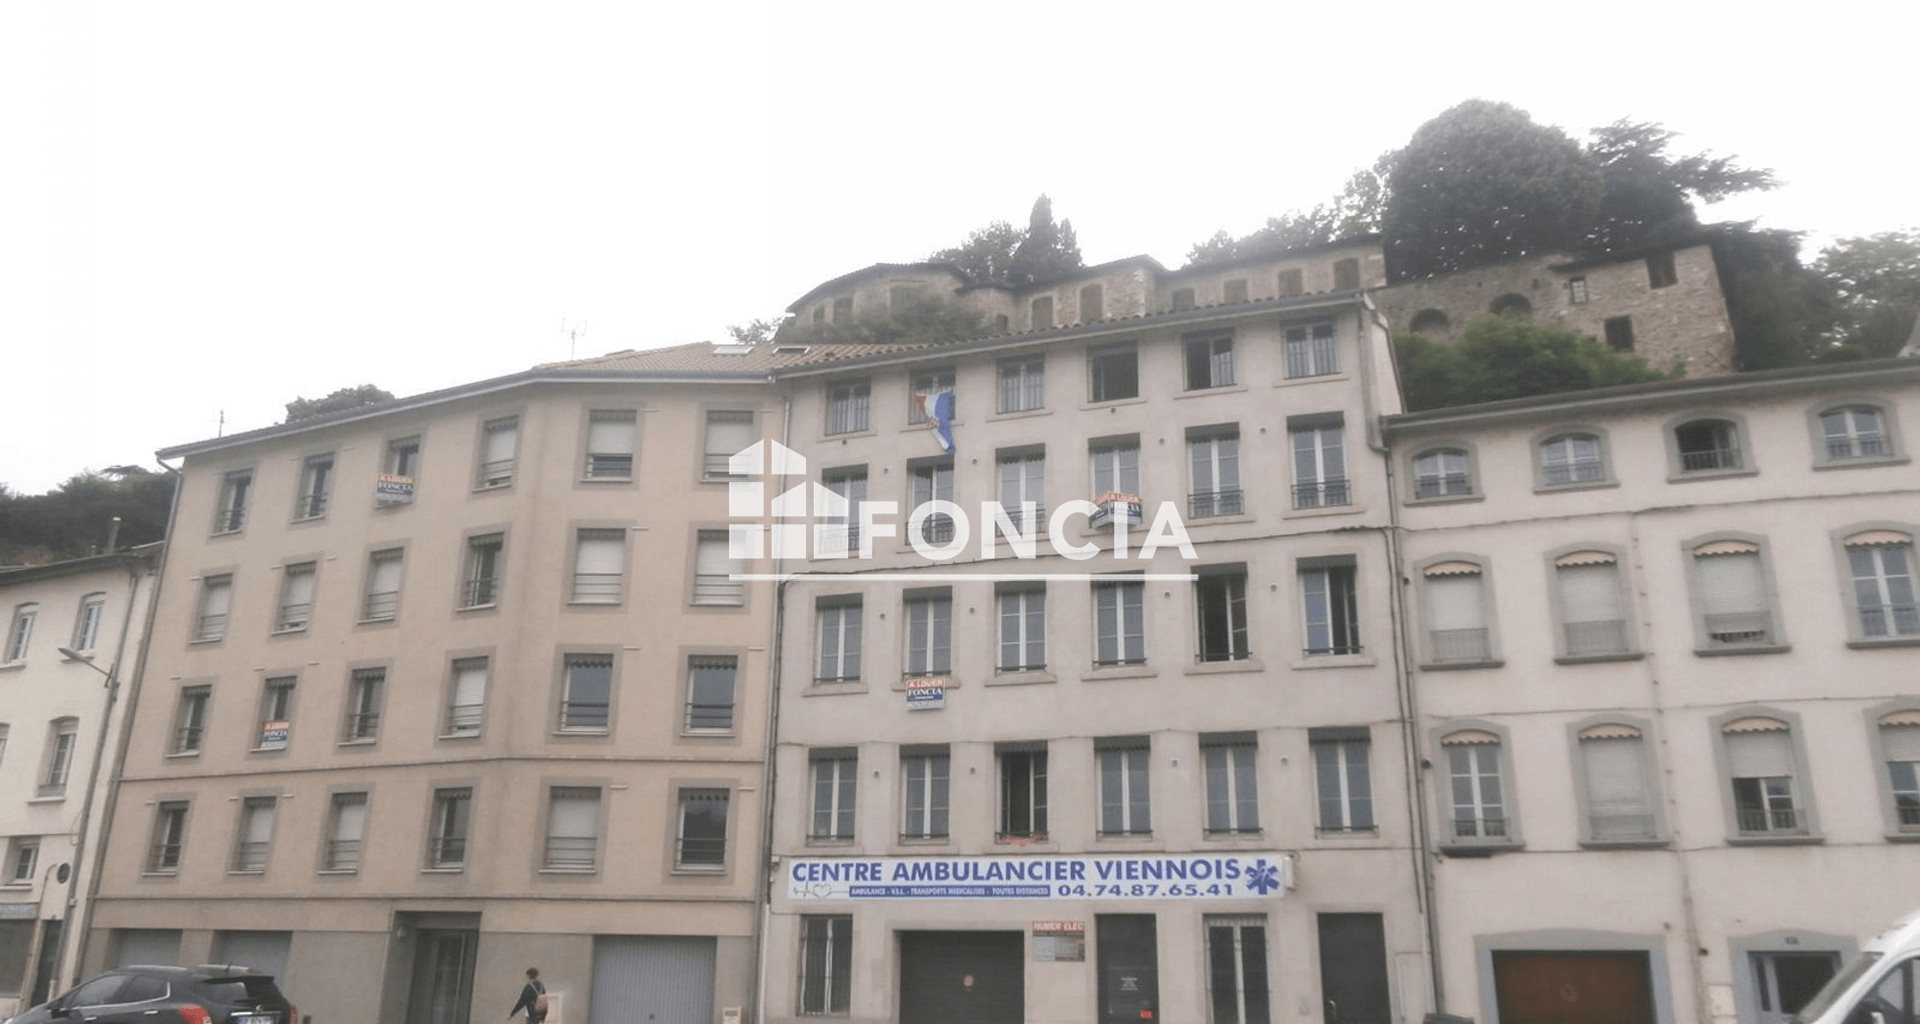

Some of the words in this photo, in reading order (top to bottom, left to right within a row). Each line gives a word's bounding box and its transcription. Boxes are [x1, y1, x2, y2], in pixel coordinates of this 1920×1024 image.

[917, 680, 942, 688] LOUER
[908, 688, 942, 696] FONCIA
[792, 863, 882, 882] CENTRE
[892, 861, 1085, 882] AMBULANCIER
[1095, 859, 1241, 880] VIENNOIS
[851, 887, 886, 896] AMBULANCE
[910, 887, 946, 896] TRANSPORTS
[992, 887, 1014, 896] TOUTES
[1015, 887, 1048, 896] DISTANCES
[1058, 883, 1233, 897] 04.74.87.65.41
